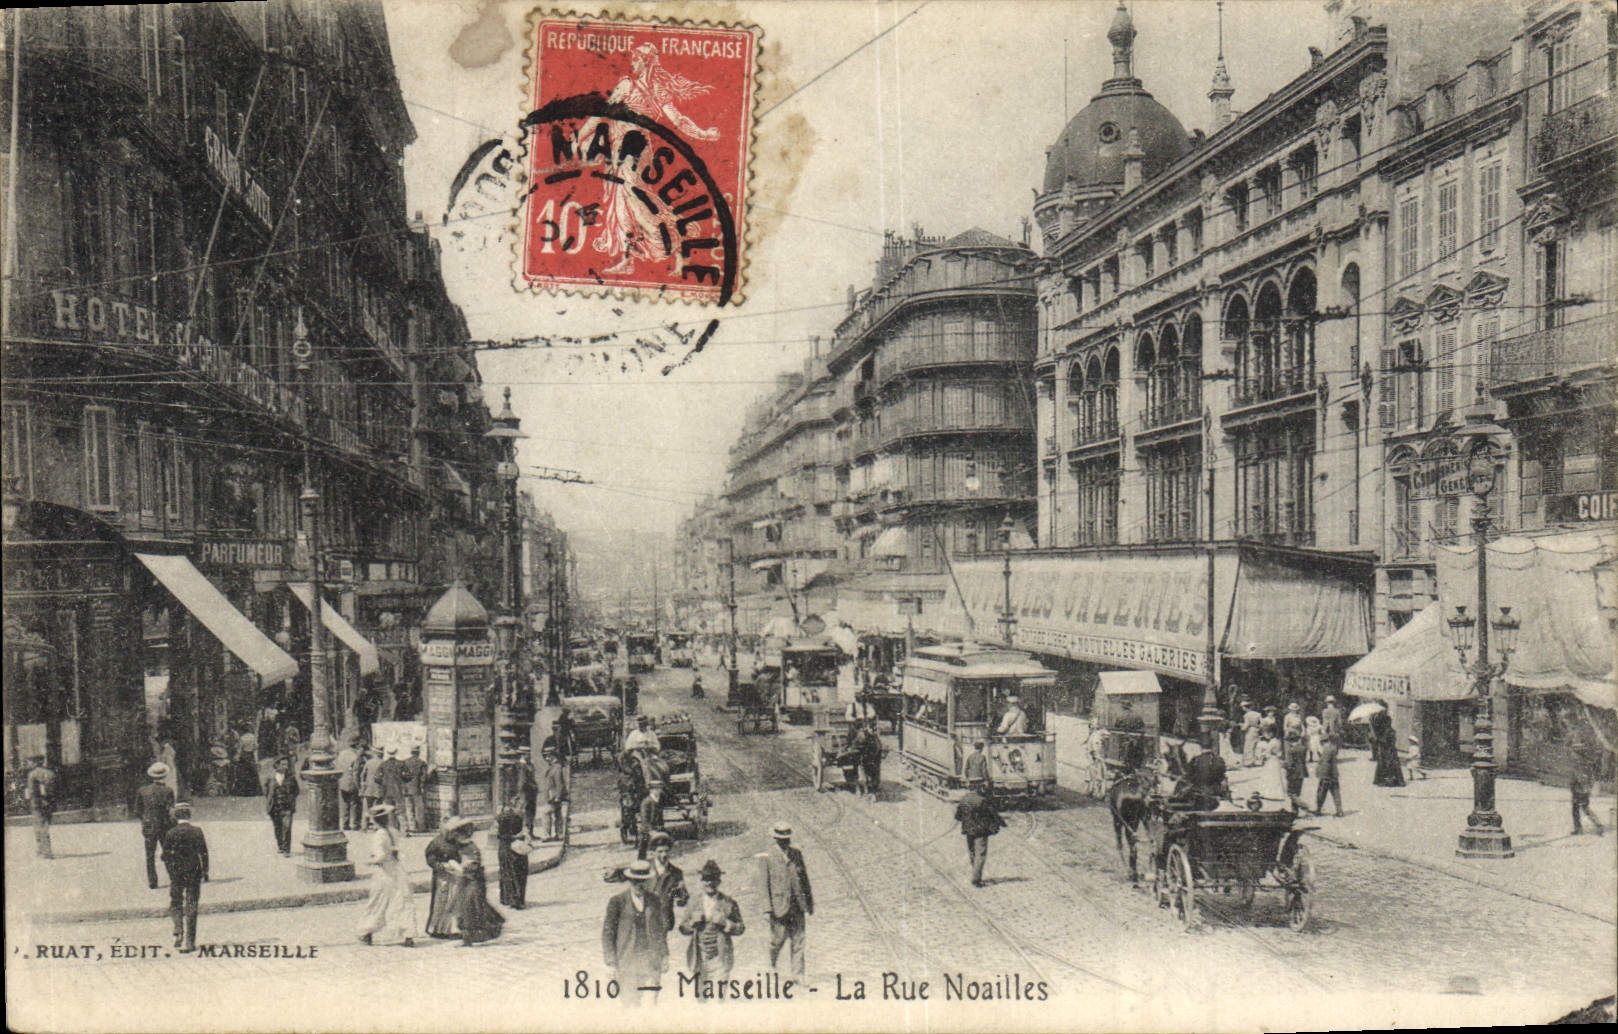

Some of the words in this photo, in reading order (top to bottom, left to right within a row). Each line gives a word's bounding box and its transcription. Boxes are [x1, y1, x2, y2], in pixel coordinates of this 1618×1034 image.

[661, 37, 744, 59] FRANÇAISE
[202, 542, 283, 565] PARFUMEUR
[1077, 637, 1136, 661] NOUVELLES
[1139, 646, 1197, 671] GALERIES
